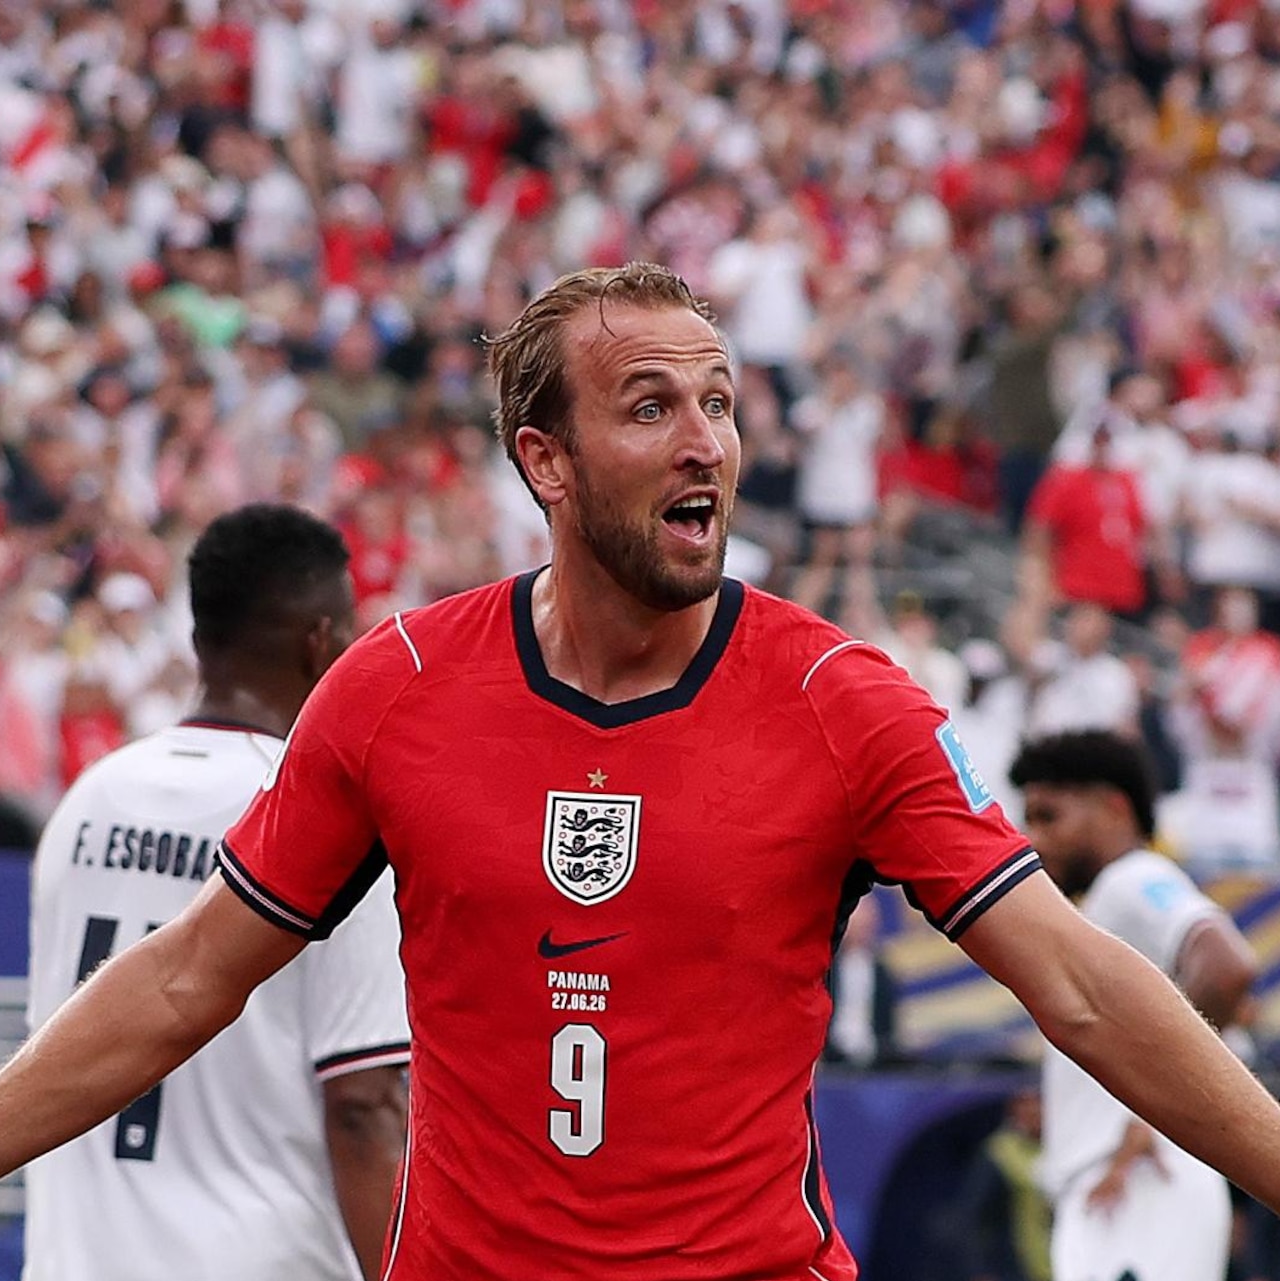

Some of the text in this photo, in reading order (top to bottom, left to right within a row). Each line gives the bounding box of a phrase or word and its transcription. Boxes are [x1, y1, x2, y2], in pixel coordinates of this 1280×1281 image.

[72, 821, 93, 867] F.
[548, 970, 610, 991] PANAMA
[552, 992, 606, 1012] 27.06.26
[550, 1024, 606, 1156] 9
